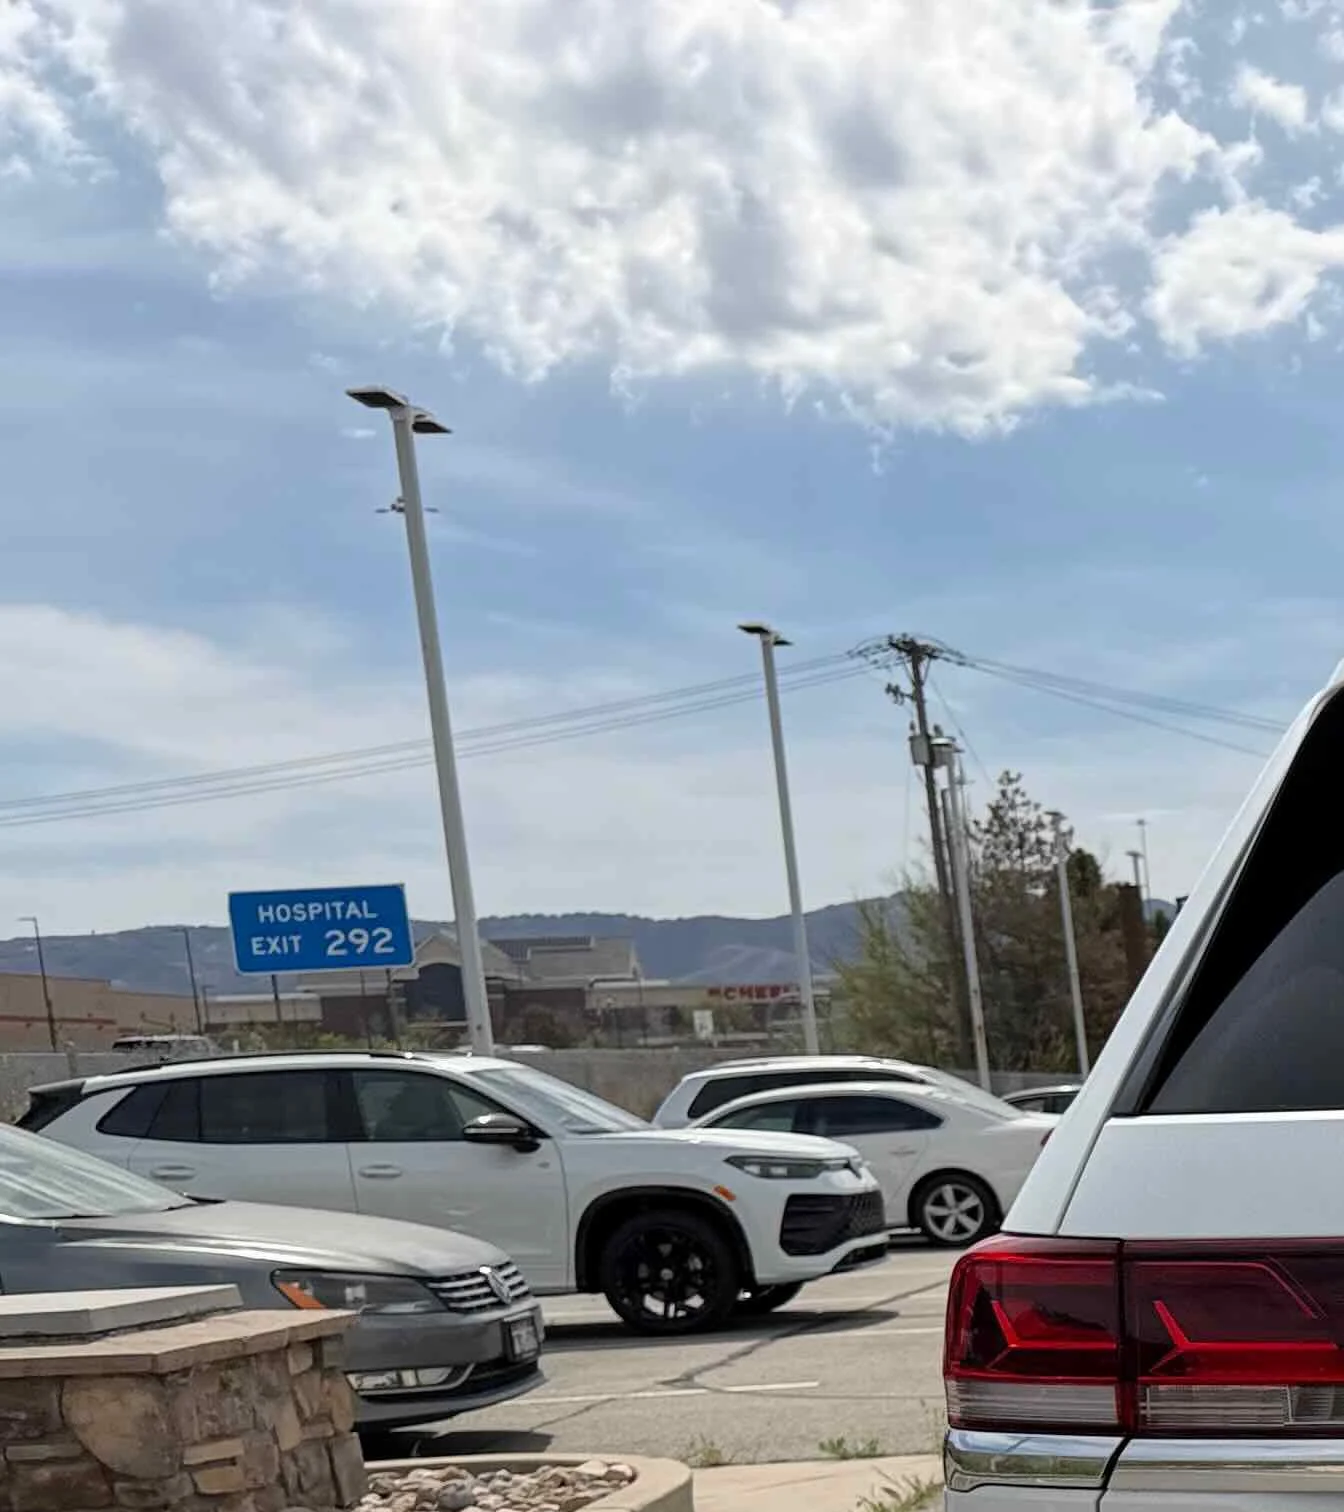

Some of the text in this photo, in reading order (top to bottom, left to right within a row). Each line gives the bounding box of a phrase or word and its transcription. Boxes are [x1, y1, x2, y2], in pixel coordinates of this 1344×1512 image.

[258, 900, 378, 924] HOSPITAL
[251, 927, 396, 957] EXIT 292
